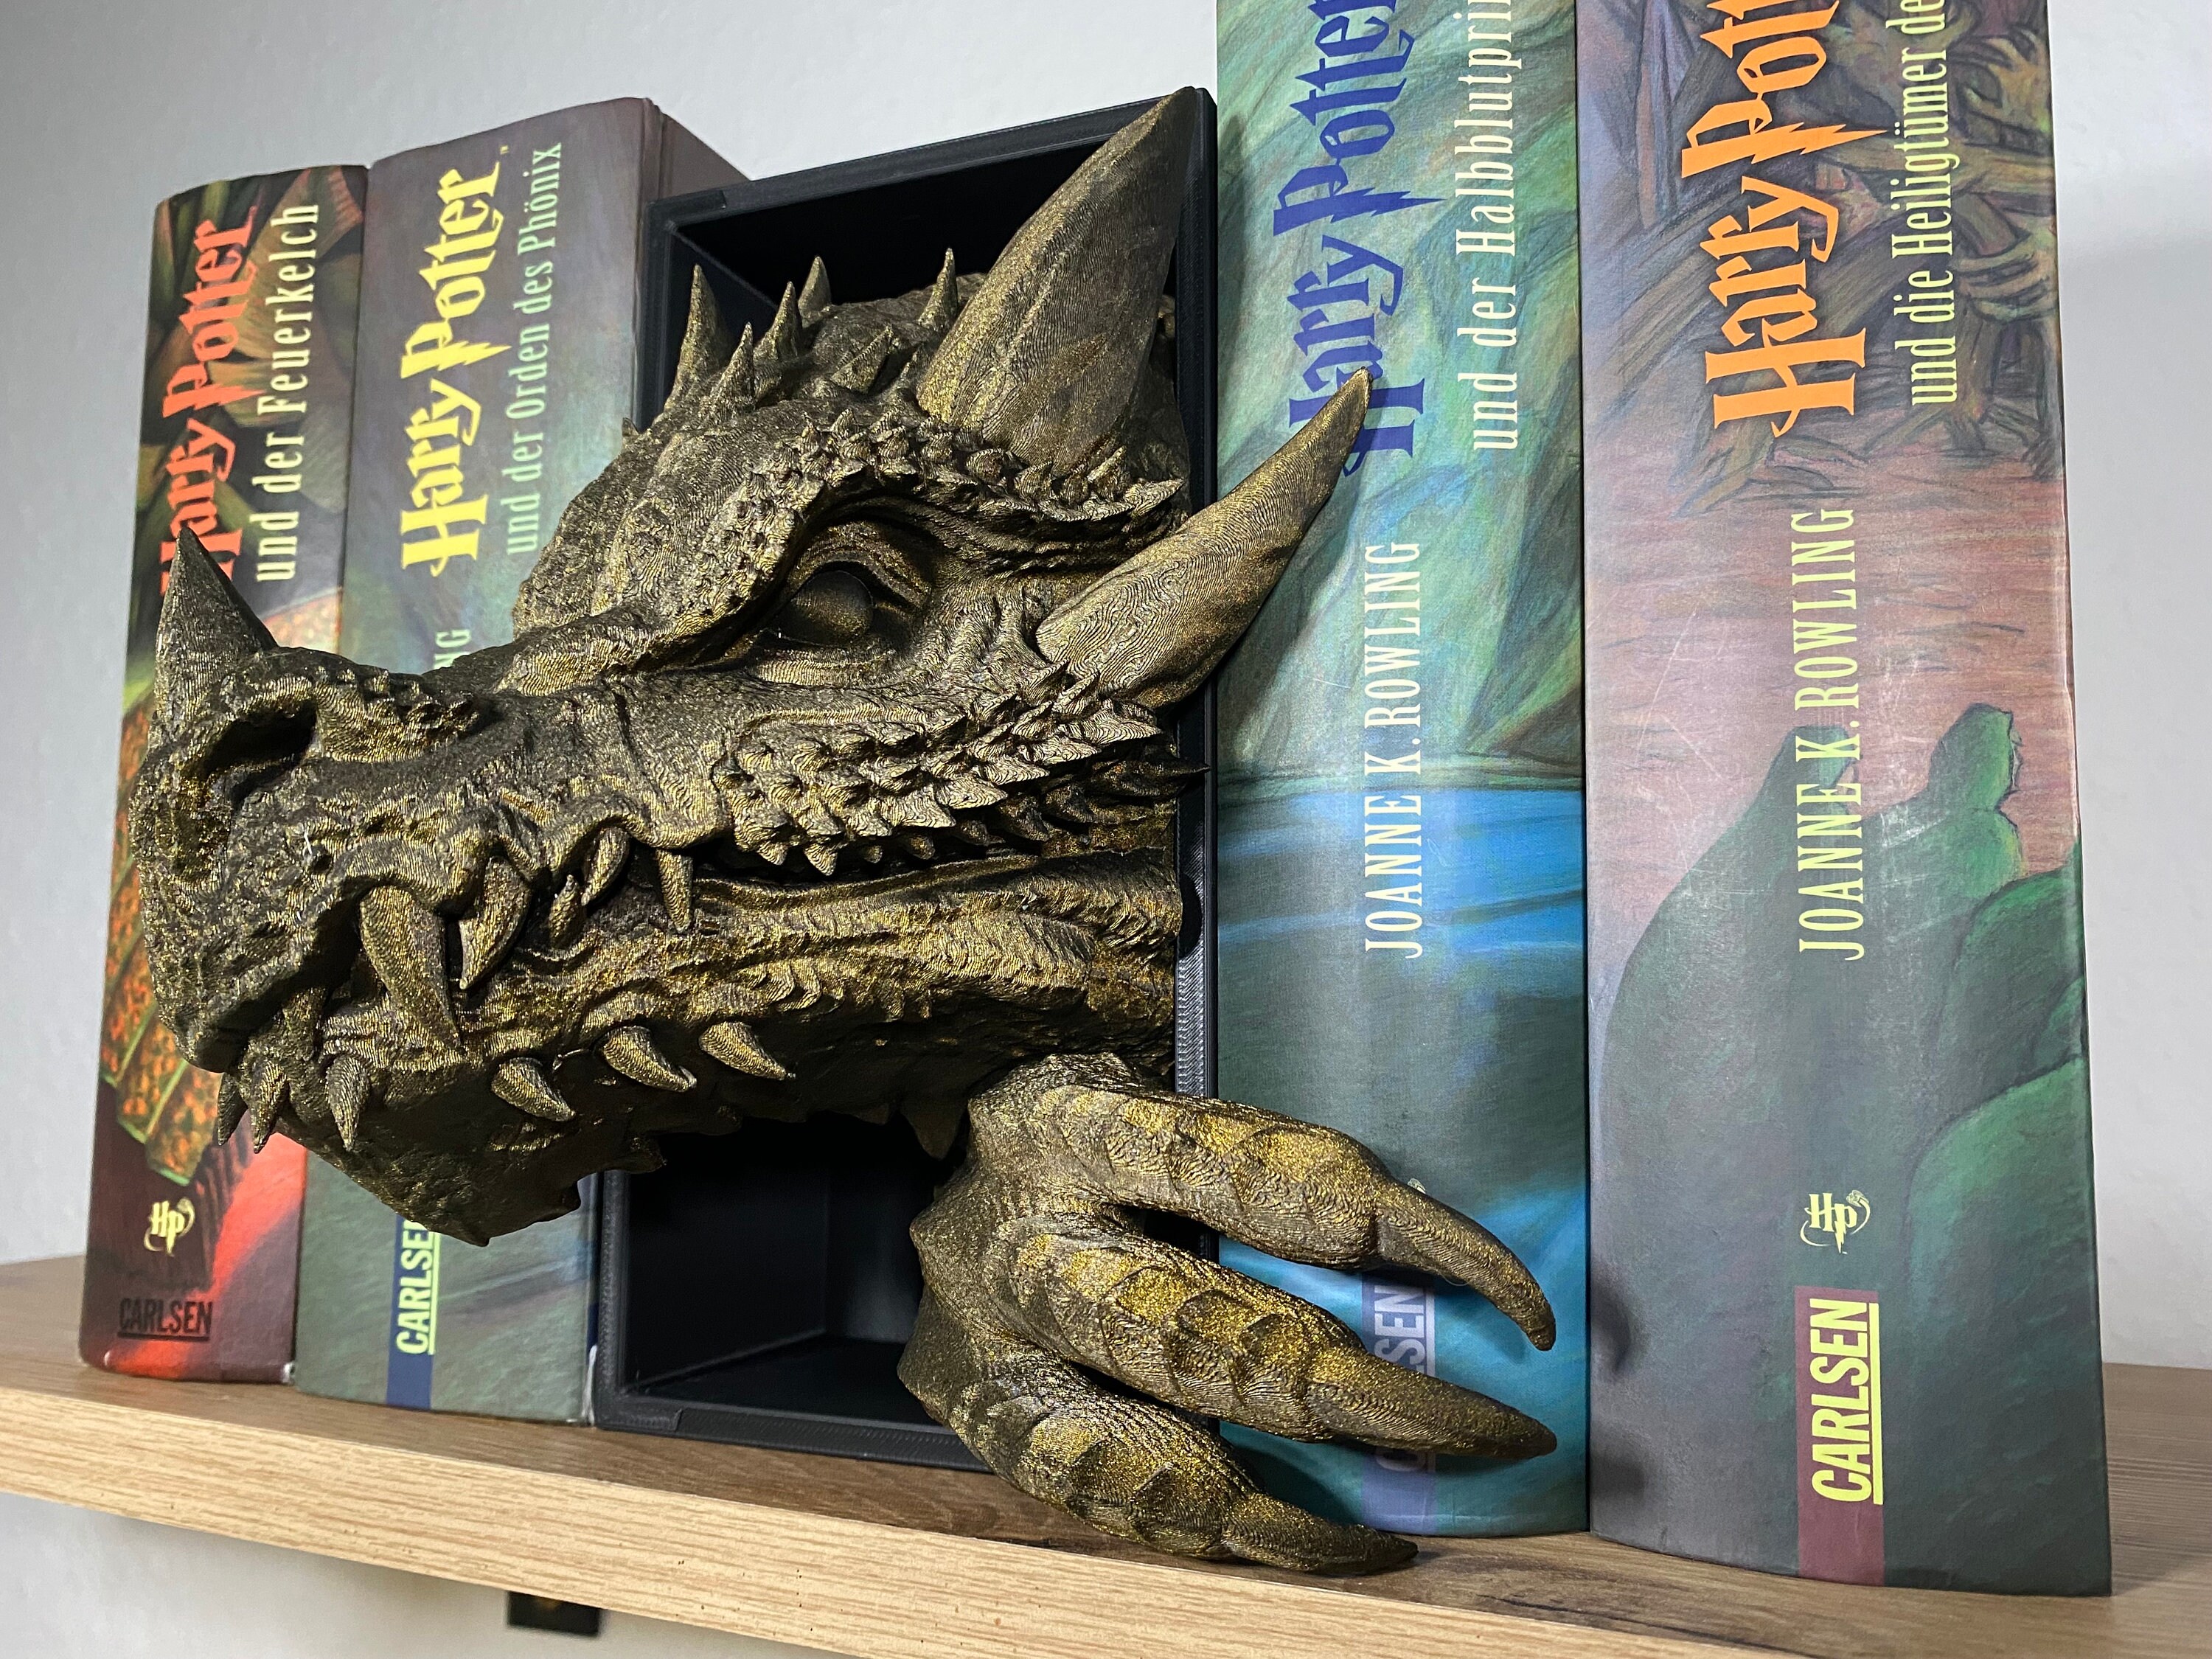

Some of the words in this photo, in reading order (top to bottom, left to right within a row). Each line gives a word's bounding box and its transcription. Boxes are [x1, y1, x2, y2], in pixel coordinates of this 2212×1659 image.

[518, 142, 562, 254] Phönix
[1891, 47, 1960, 259] Heiligtümer
[162, 205, 265, 418] Potter
[257, 204, 319, 415] Feuerkelch
[400, 160, 511, 379] Potter
[514, 260, 551, 316] des
[1457, 277, 1516, 347] der
[1699, 175, 1866, 437] Harry
[1893, 270, 1954, 323] die
[507, 322, 549, 421] Orden
[1287, 234, 1425, 477] Harry
[1458, 372, 1517, 451] und
[1894, 335, 1958, 406] und
[251, 431, 305, 494] der
[400, 378, 487, 577] Harry
[498, 498, 538, 555] und
[503, 433, 543, 489] der
[249, 512, 300, 582] und
[1792, 508, 1860, 713] ROWLING
[1364, 541, 1421, 730] ROWLING
[1365, 793, 1424, 960] JOANNE
[1796, 782, 1865, 961] JOANNE
[118, 1298, 213, 1335] CARLSEN
[1374, 1284, 1427, 1471] CSEN
[1809, 1299, 1873, 1502] CARLSEN
